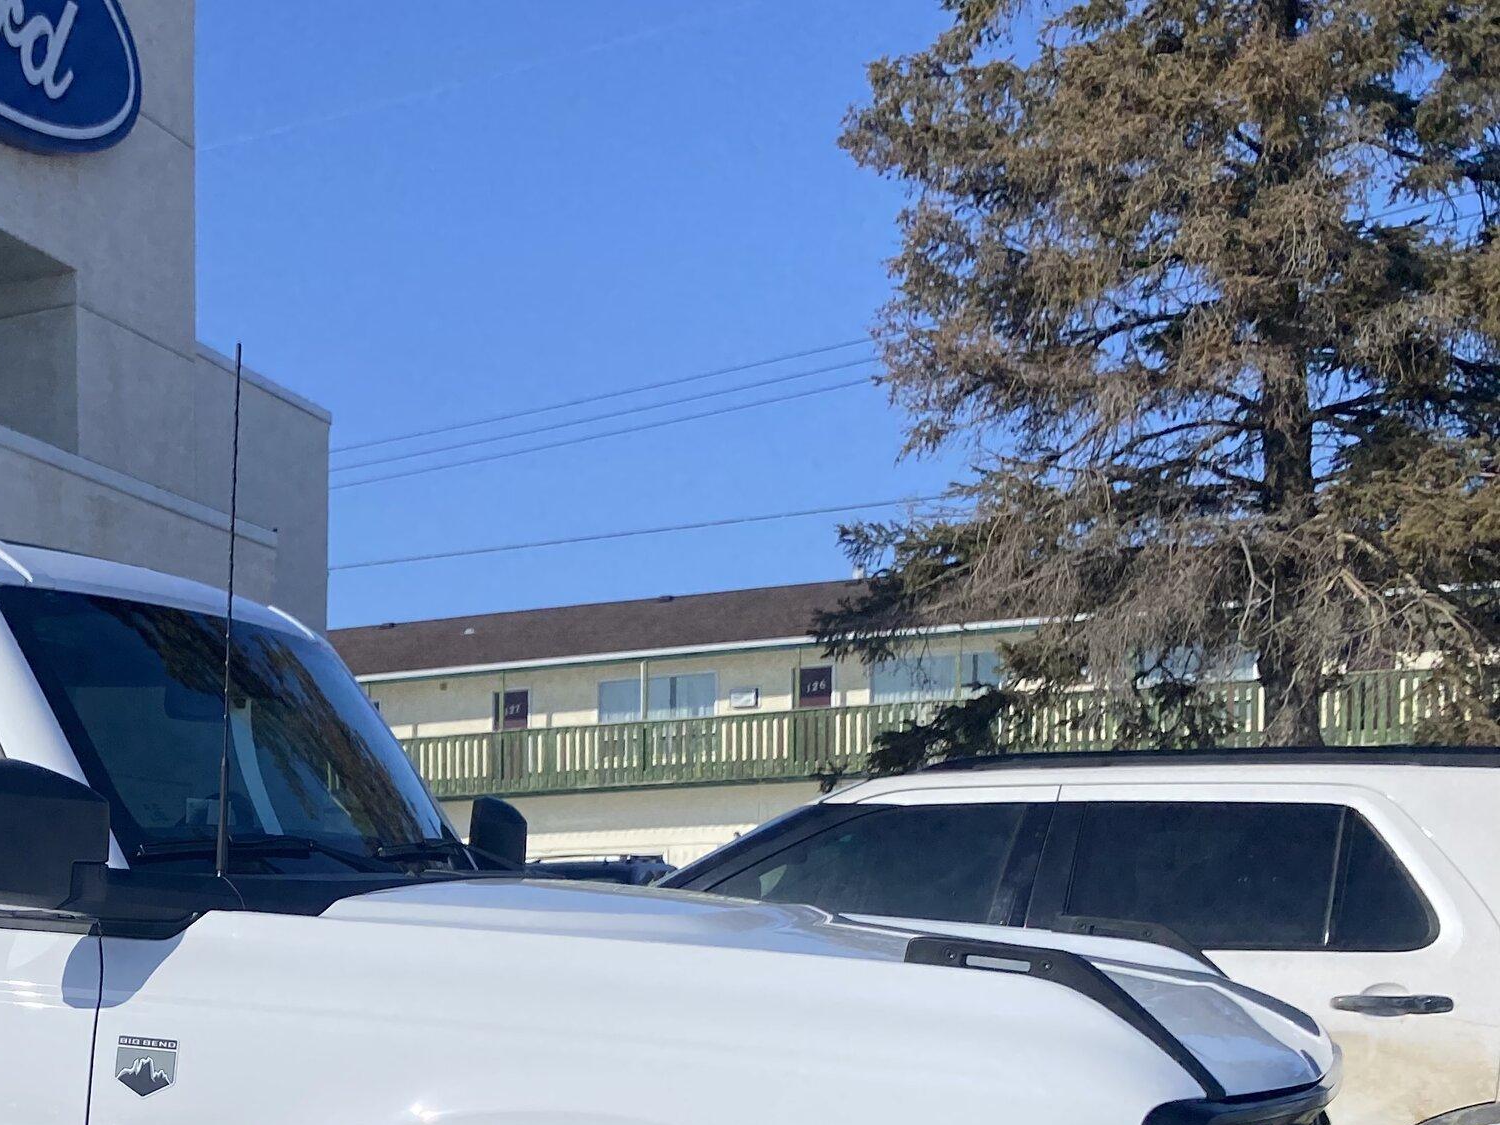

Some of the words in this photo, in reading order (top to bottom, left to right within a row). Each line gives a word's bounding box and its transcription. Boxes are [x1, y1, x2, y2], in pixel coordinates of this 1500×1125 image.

[805, 679, 827, 694] 126
[119, 1037, 141, 1045] BIG
[142, 1039, 177, 1048] BEND
